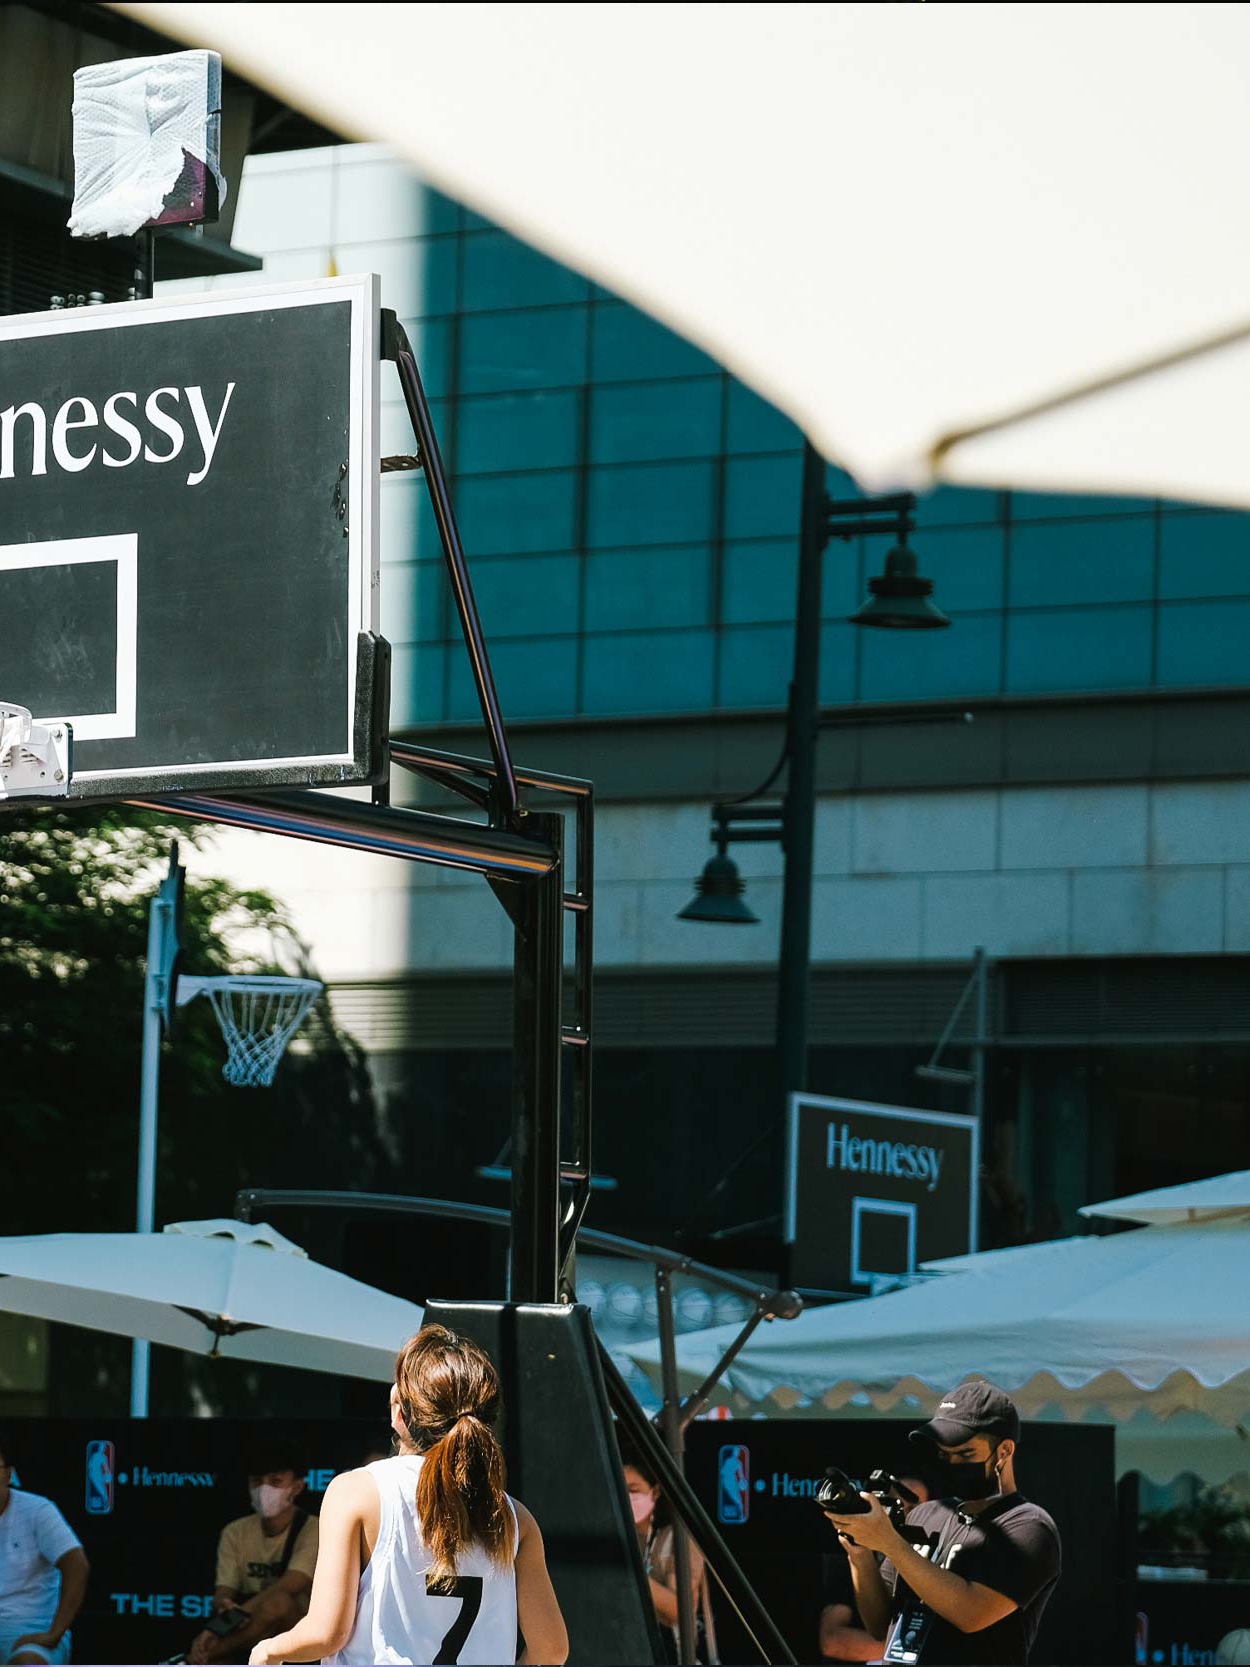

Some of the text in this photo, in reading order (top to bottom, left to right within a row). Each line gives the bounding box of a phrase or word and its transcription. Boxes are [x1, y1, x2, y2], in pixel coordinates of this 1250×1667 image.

[827, 1122, 943, 1192] Hennessy
[110, 1593, 175, 1618] THE
[426, 1573, 484, 1666] 7
